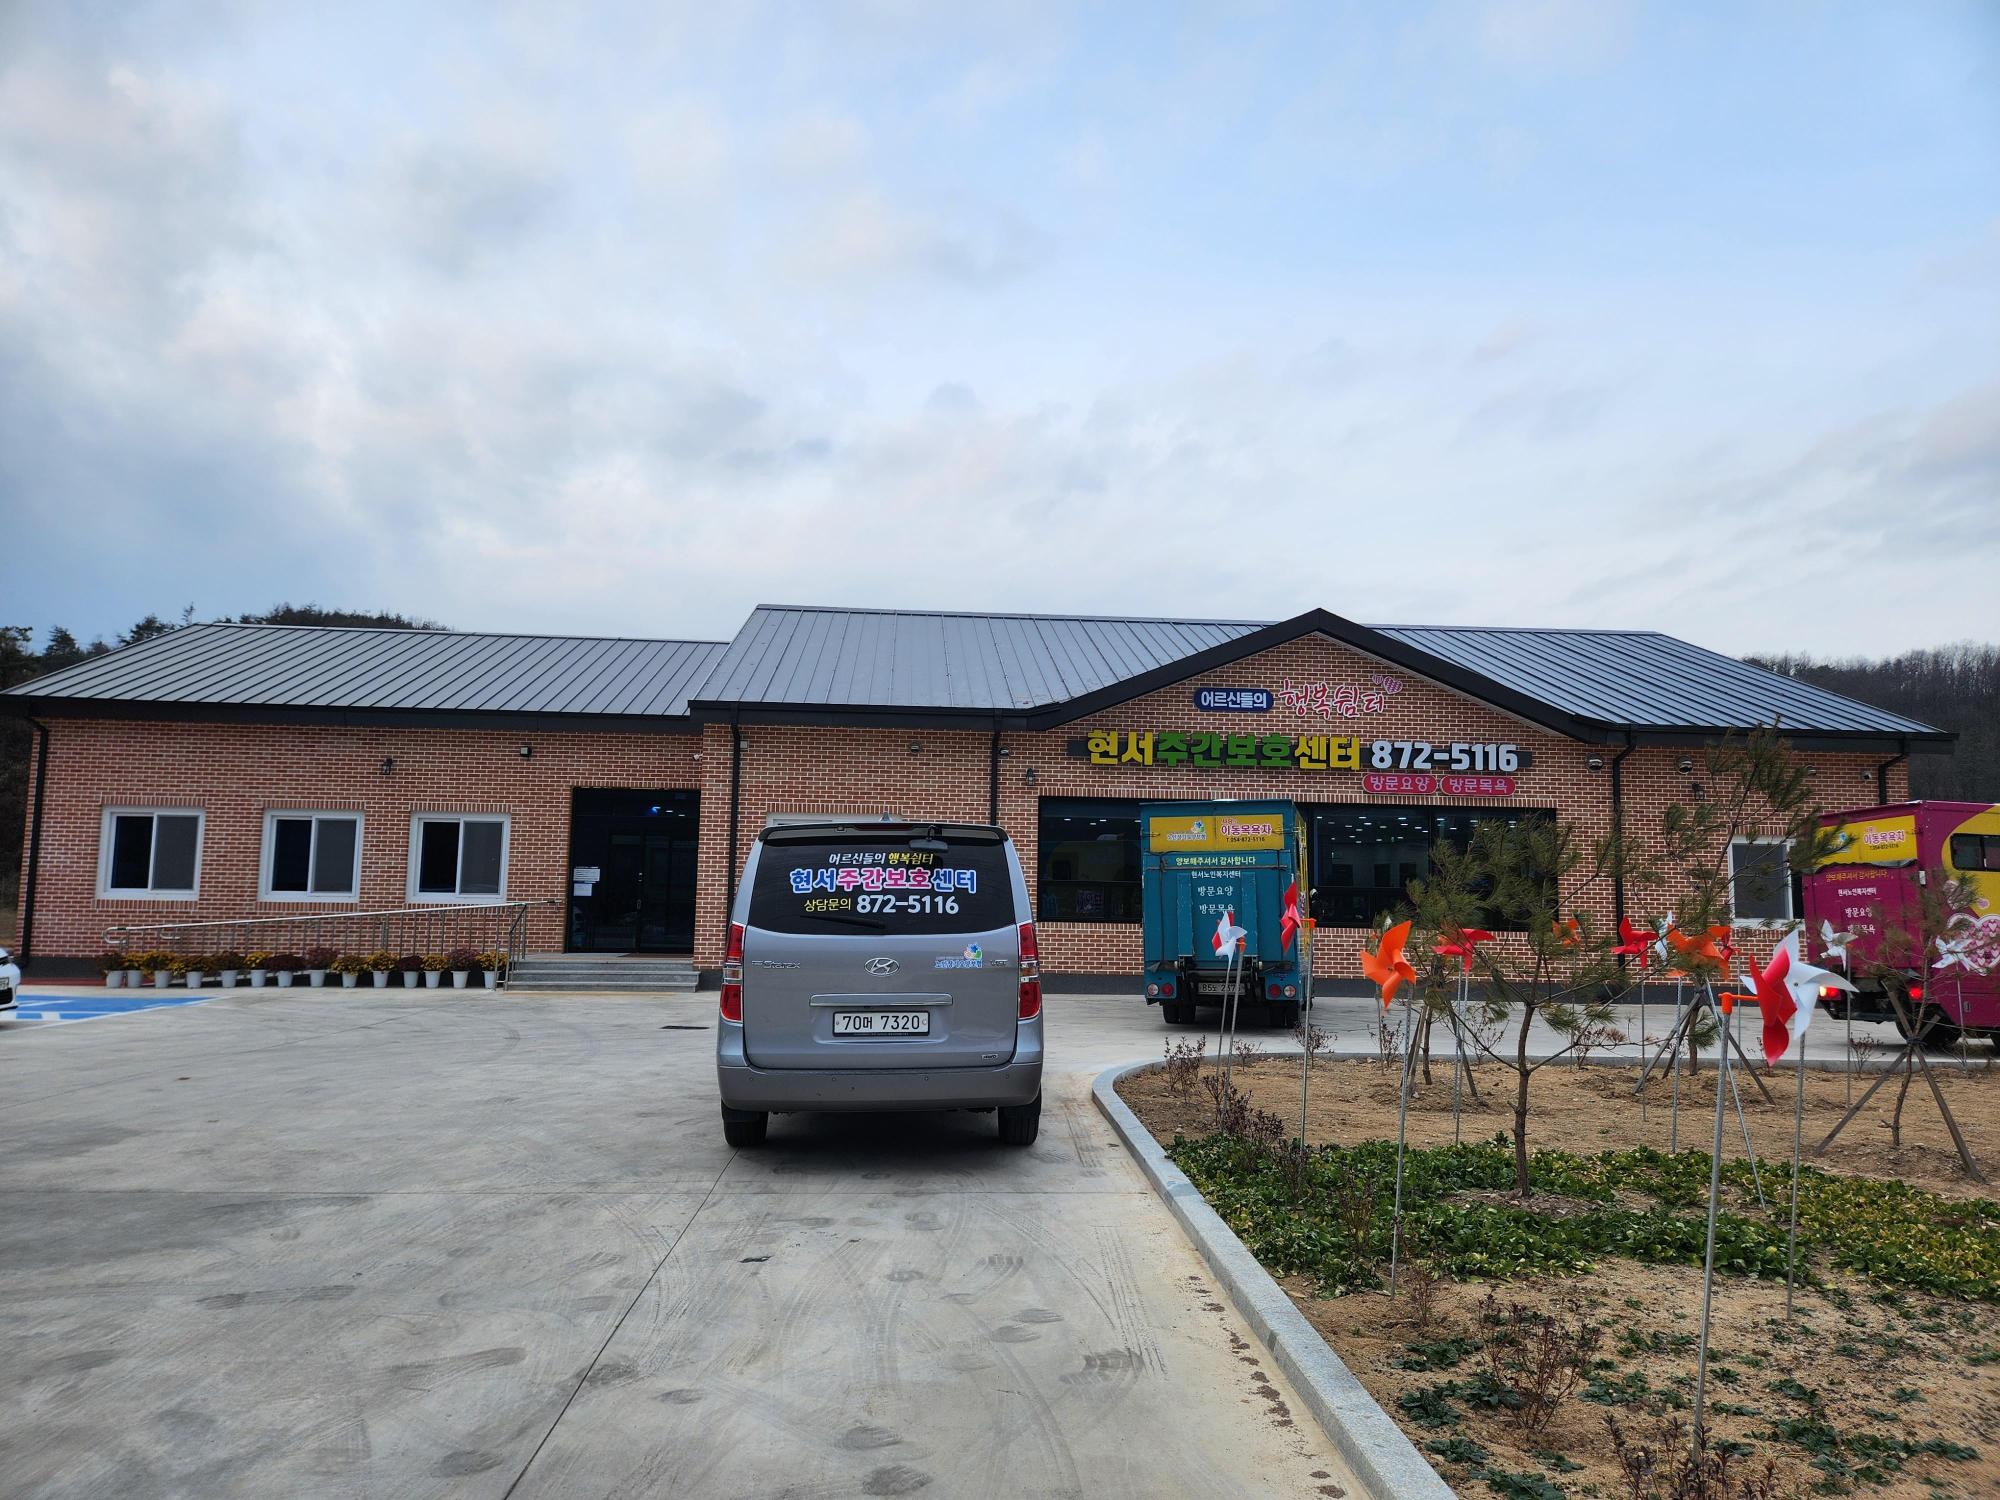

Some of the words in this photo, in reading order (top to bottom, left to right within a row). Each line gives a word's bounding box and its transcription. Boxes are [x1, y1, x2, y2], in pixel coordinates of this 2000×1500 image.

[1201, 691, 1267, 708] 어르신들의
[1279, 678, 1385, 720] 행복쉼터
[1087, 728, 1361, 771] 현서주간보호센터
[1370, 739, 1519, 773] 872-5116
[1369, 775, 1433, 792] 방문요양
[1449, 776, 1509, 795] 방문목욕
[1221, 824, 1272, 836] 이동목욕차
[1864, 830, 1905, 844] 이동목욕차
[829, 852, 886, 865] 어르신들의
[888, 852, 934, 865] 행복쉼터
[1220, 856, 1256, 865] 감사합니다
[790, 867, 977, 894] 현서주간보호센터
[1191, 870, 1241, 879] 현서노인복지센터
[1197, 886, 1233, 896] 방문요양
[803, 897, 851, 912] 상담문의
[856, 895, 959, 915] 872-5116
[1199, 904, 1235, 915] 방문목욕
[843, 1015, 873, 1030] 70머
[880, 1015, 920, 1030] 7320
